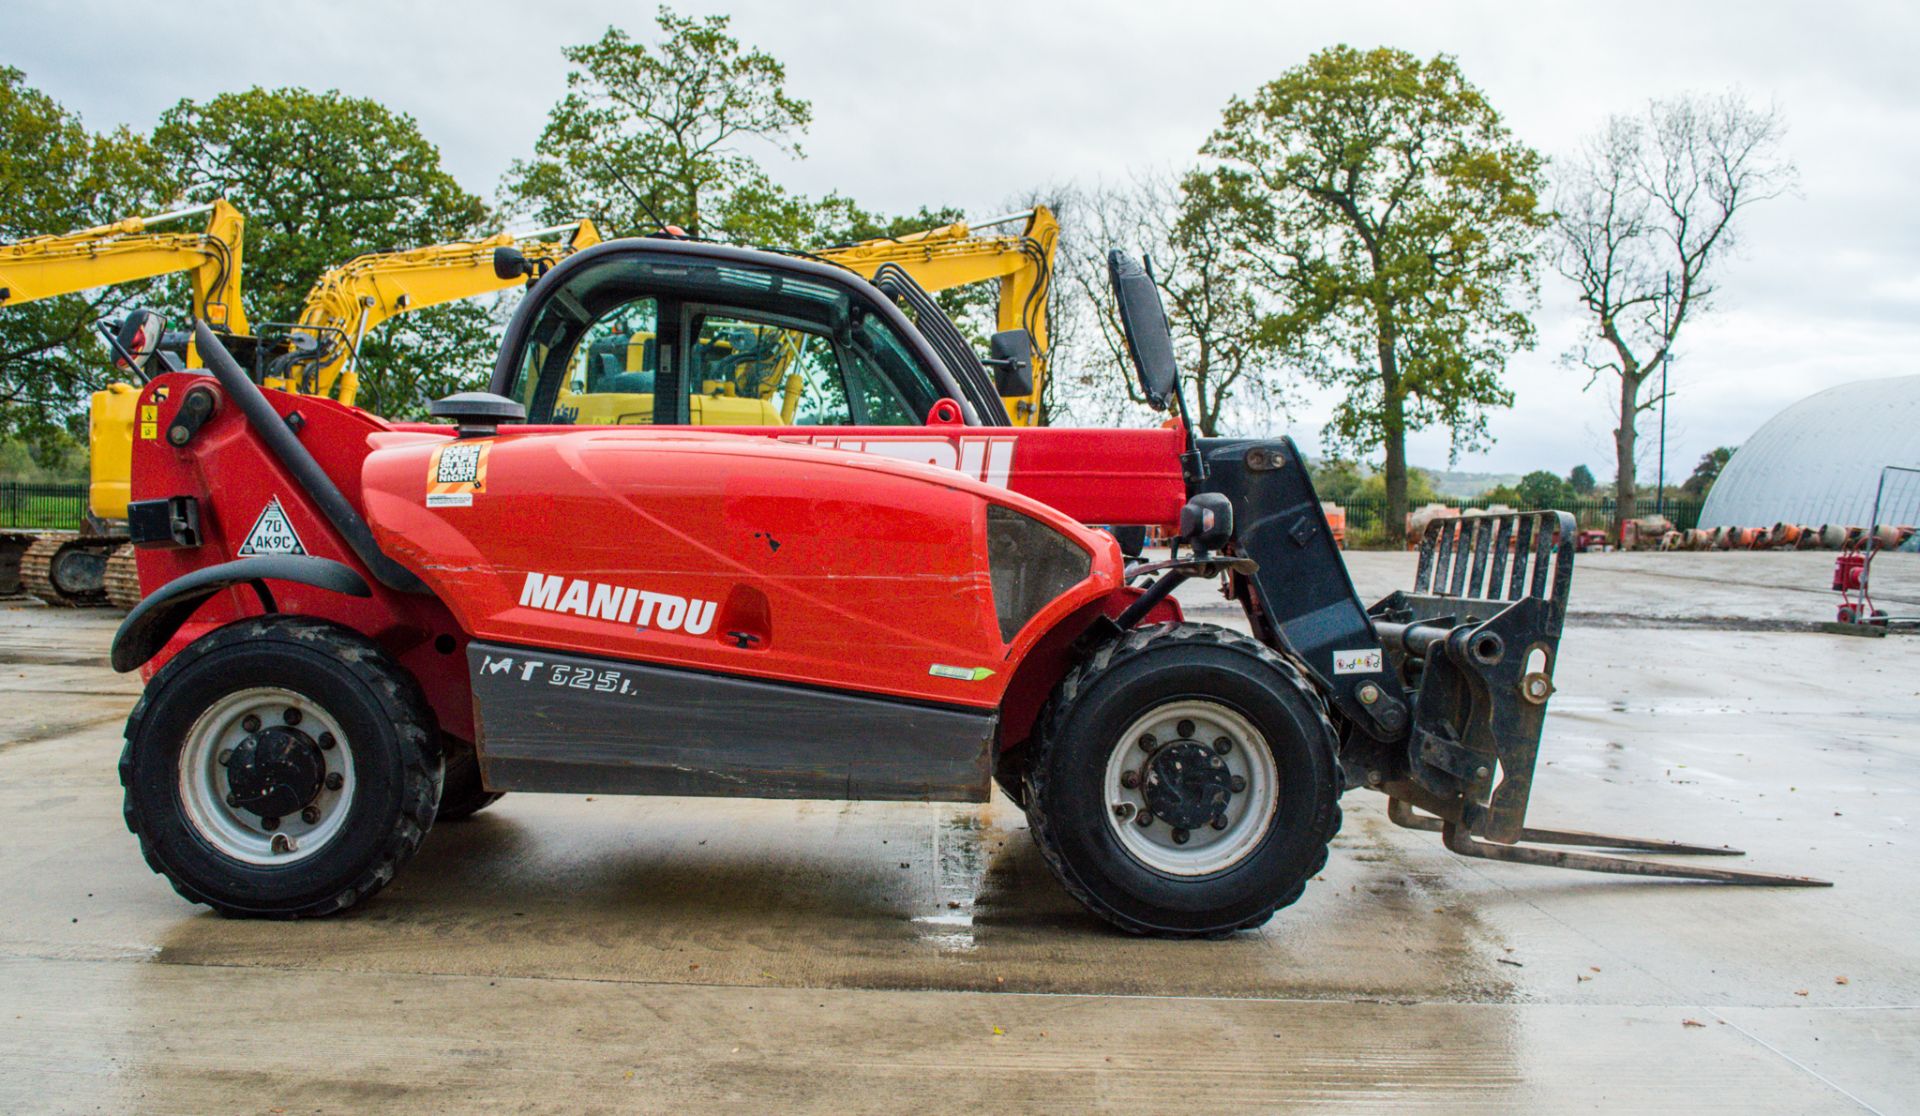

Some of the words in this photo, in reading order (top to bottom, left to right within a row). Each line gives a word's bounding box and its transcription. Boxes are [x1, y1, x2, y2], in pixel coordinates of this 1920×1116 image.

[439, 467, 476, 476] OVER
[256, 536, 290, 549] AK9C
[518, 571, 718, 635] MANITOU
